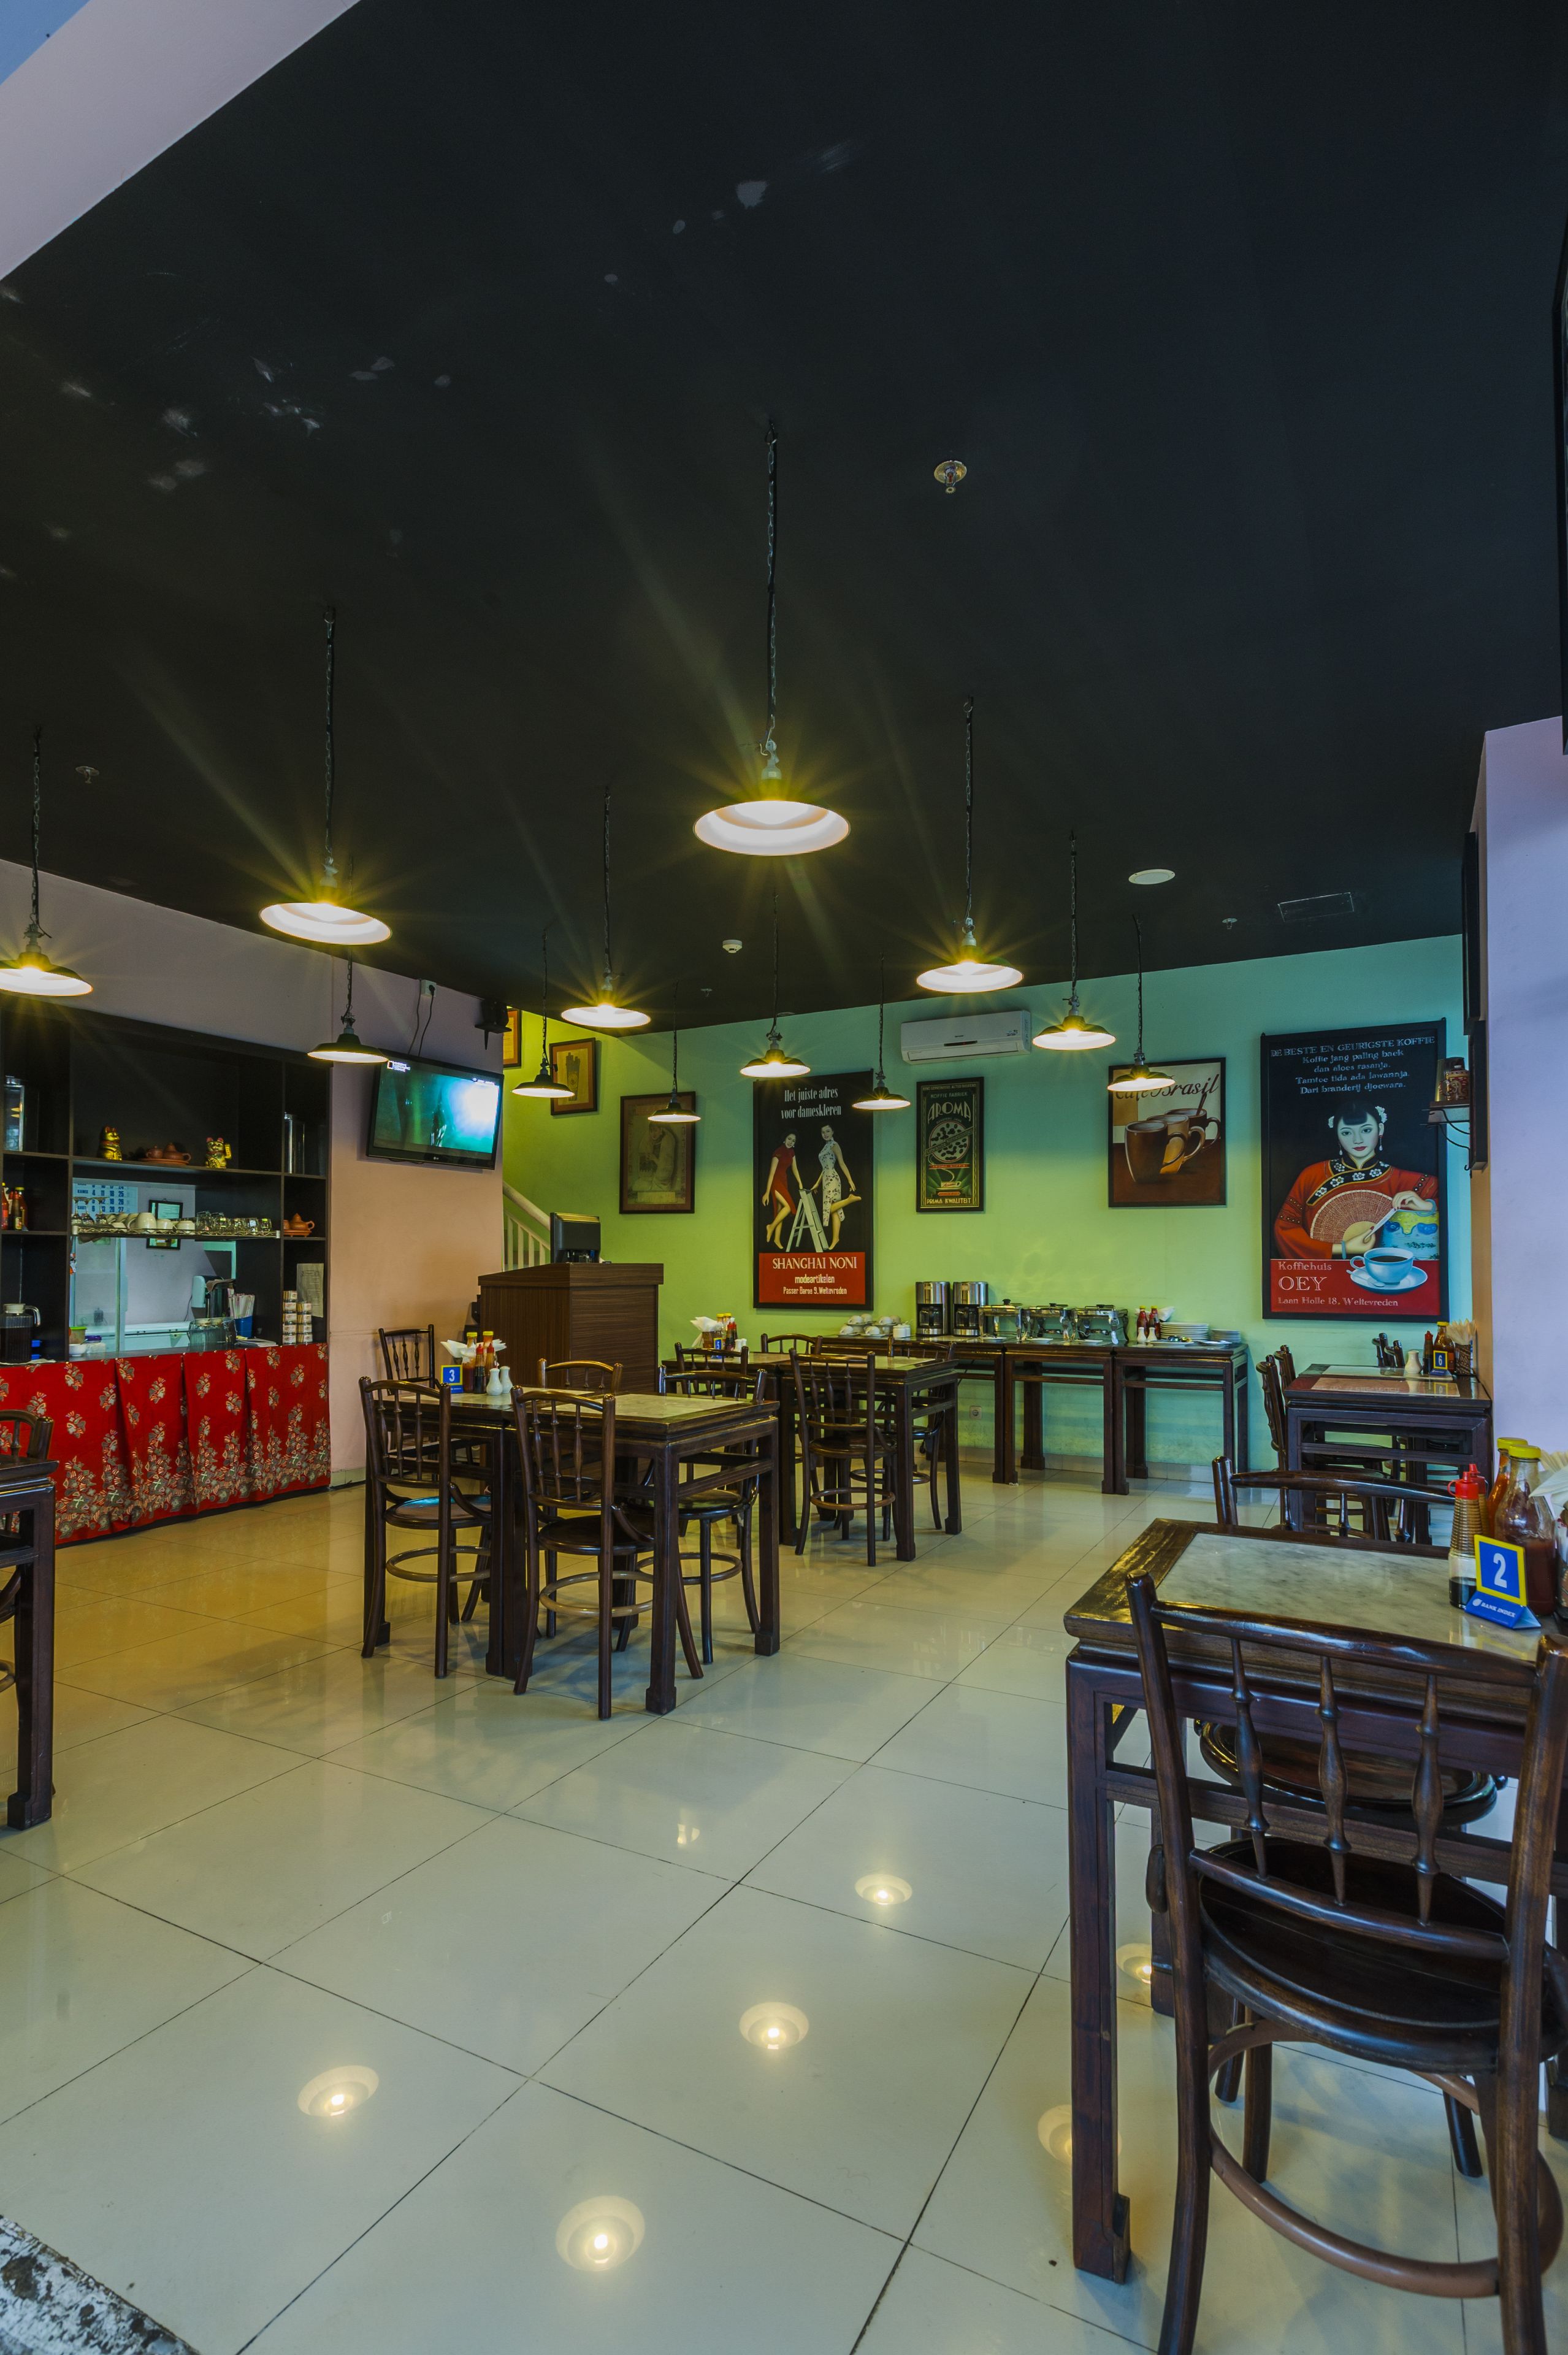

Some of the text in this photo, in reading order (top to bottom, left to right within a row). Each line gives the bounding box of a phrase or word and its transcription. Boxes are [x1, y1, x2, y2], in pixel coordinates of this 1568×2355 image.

[1283, 1046, 1317, 1056] BESTE
[1320, 1044, 1334, 1053] EN
[1337, 1040, 1394, 1051] GEURIGSTE
[1397, 1036, 1436, 1046] KOFFIE
[1302, 1055, 1328, 1063] Koffie
[1329, 1054, 1349, 1063] jang
[1352, 1052, 1379, 1062] paling
[784, 1086, 838, 1103] Het juiste adres
[781, 1104, 841, 1119] voor dameskleren
[928, 1101, 971, 1124] AROMA
[773, 1257, 857, 1269] SHANGHAI NONI
[1278, 1261, 1332, 1271] Koffiehuis
[795, 1274, 835, 1284] modeartikelen
[1278, 1276, 1328, 1291] OEY
[783, 1286, 799, 1295] Passer
[1342, 1297, 1399, 1307] Weltevreden
[1438, 1355, 1442, 1366] 6
[449, 1369, 455, 1382] 3
[1493, 1552, 1507, 1588] 2
[1481, 1602, 1516, 1618] BANK INDEX
